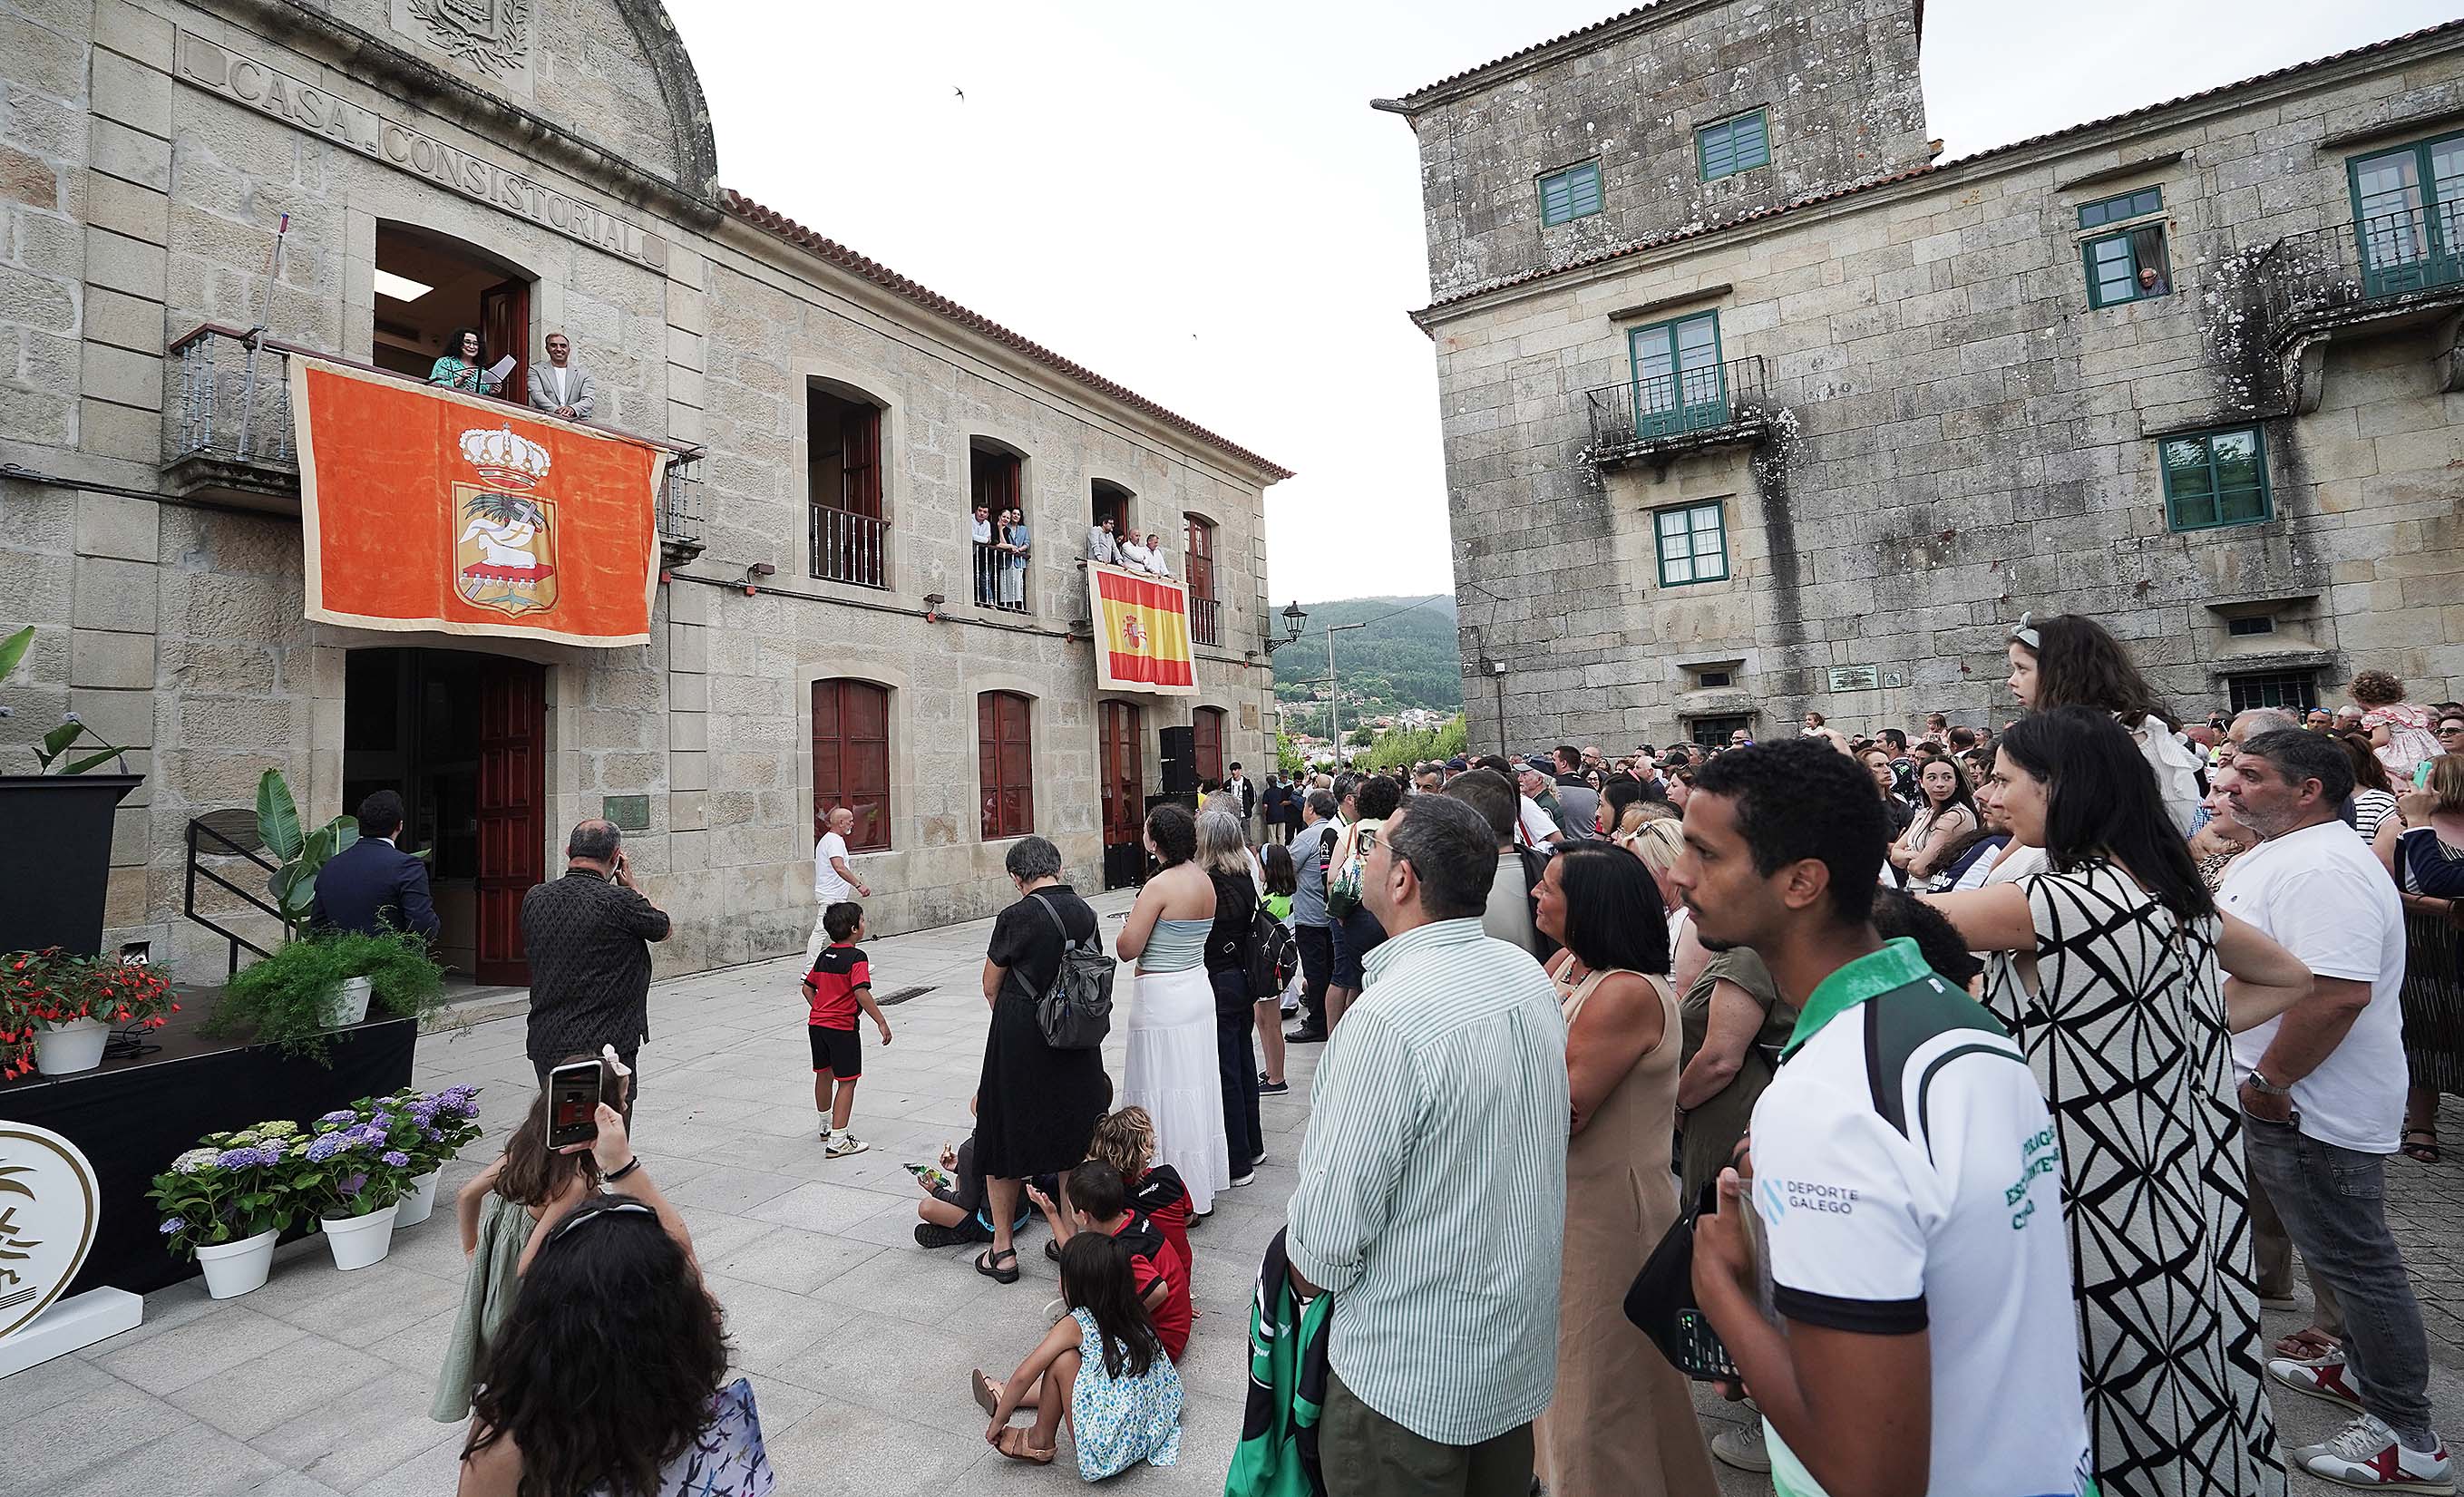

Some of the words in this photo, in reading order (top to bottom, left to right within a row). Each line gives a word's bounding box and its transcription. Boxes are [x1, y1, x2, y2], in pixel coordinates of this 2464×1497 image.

[229, 60, 355, 144] CASA
[382, 124, 642, 259] CONSISTORIAL
[1787, 1181, 1858, 1201] DEPORTE
[1789, 1196, 1852, 1214] GALEGO
